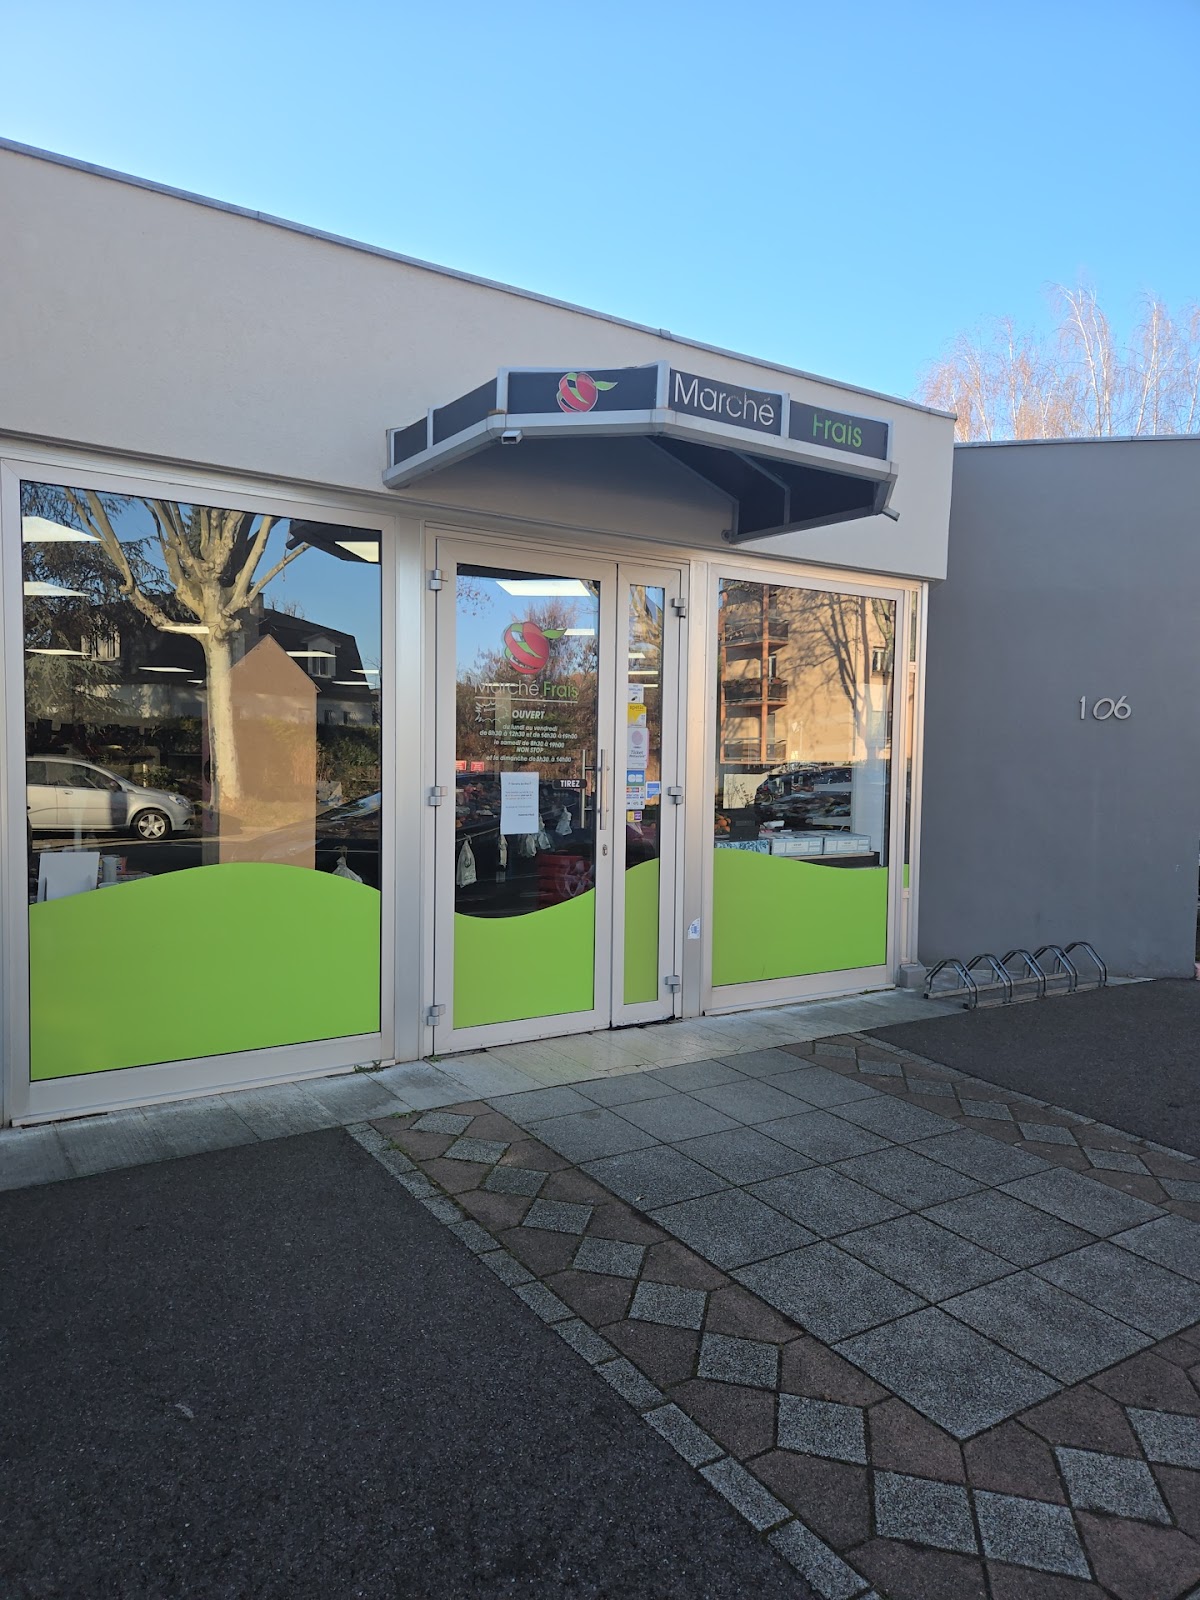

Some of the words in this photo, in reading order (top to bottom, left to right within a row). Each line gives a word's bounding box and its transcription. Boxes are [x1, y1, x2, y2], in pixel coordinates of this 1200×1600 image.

[674, 373, 775, 426] Marché
[812, 413, 863, 448] Frais
[473, 680, 540, 696] Marché
[543, 681, 579, 698] Frais
[1079, 695, 1132, 720] 106
[511, 710, 546, 720] OUVERT
[499, 754, 528, 762] dimanche
[560, 780, 581, 788] TIREZ
